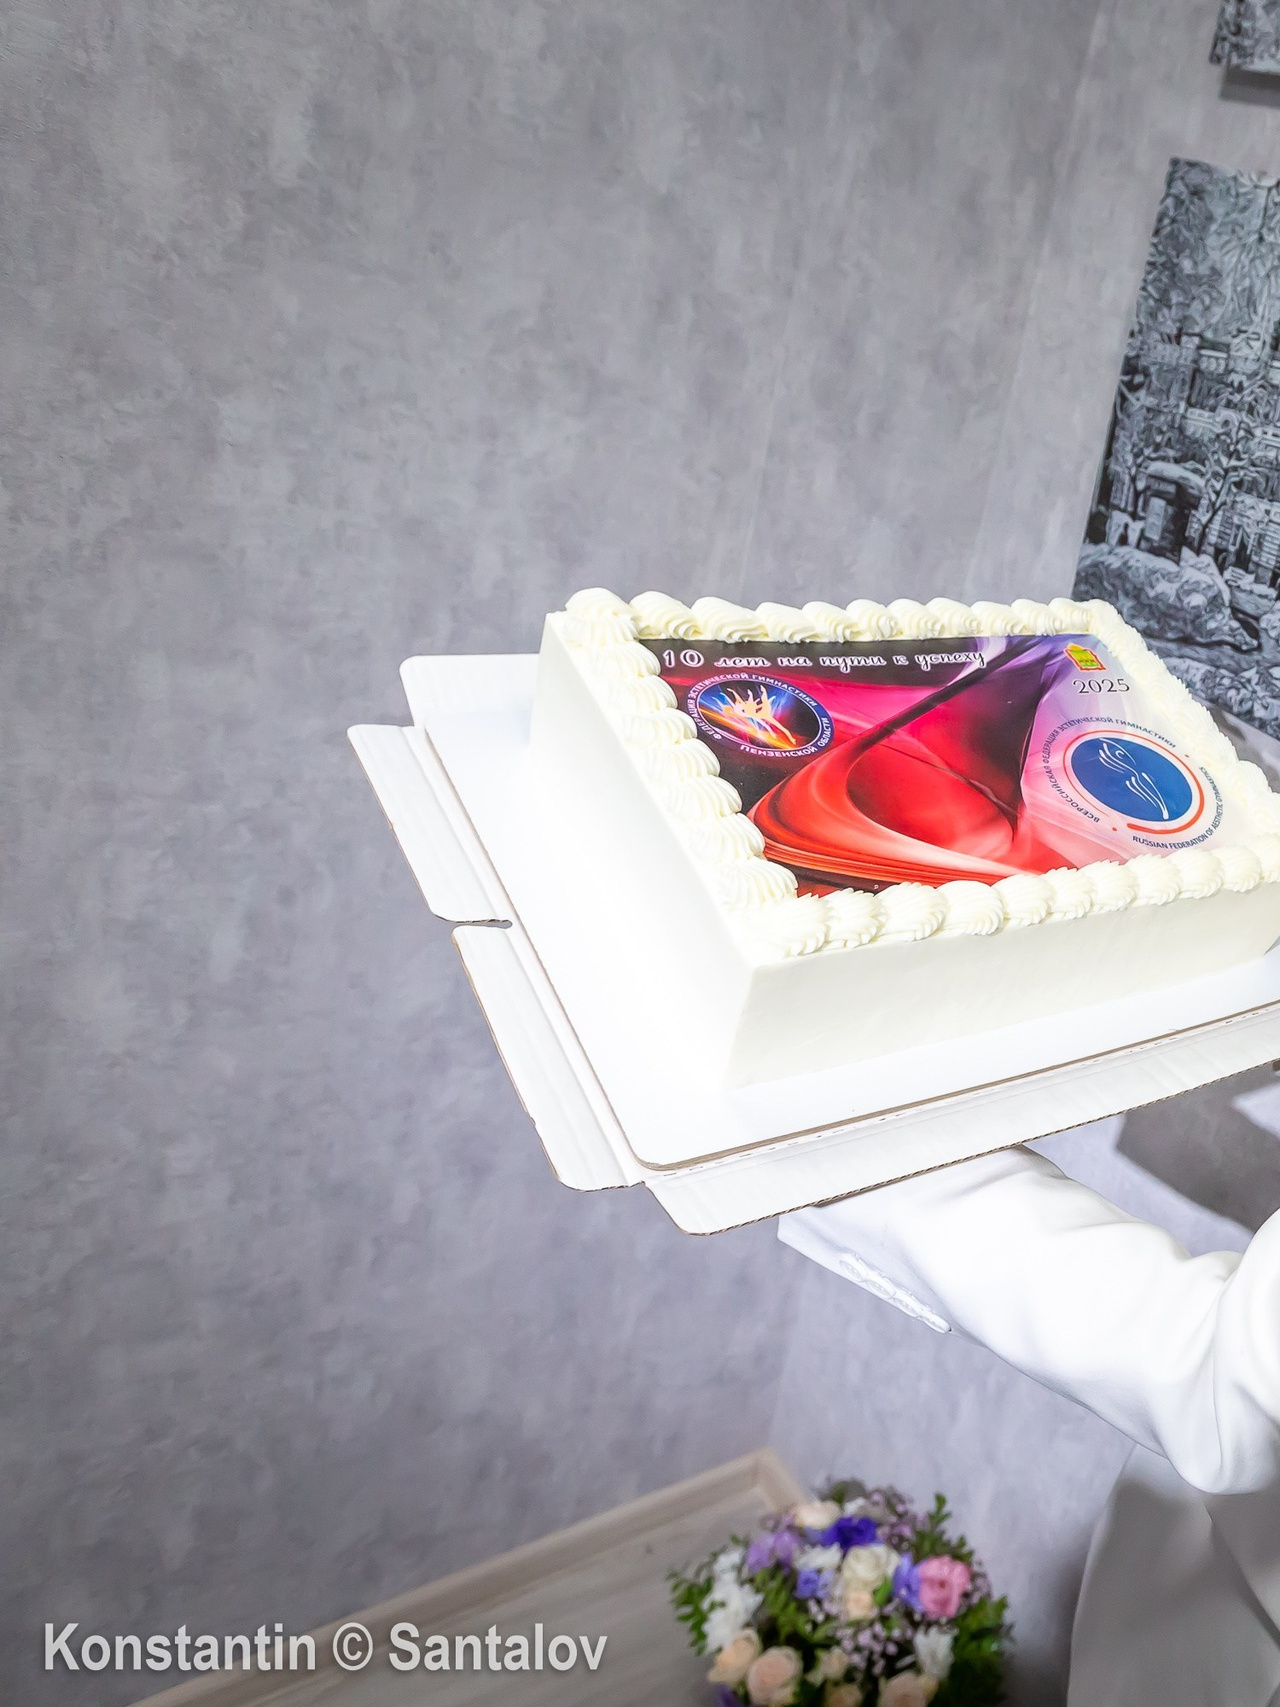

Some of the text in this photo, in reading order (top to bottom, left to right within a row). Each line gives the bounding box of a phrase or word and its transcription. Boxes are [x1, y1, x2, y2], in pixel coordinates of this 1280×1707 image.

[663, 649, 986, 673] 10 лет на пути к успеху
[687, 672, 818, 740] ФЕДЕРАЦИЯ ЭСТЕТИЧЕСКОЙ ГИМНАСТИКИ
[1073, 678, 1130, 694] 2025
[740, 717, 831, 758] ПЕНЗЕНСКОЙ ОБЛАСТИ
[1042, 716, 1176, 823] ВСЕРОССИЙСКАЯ ФЕДЕРАЦИЯ ЭСТЕТИЧЕСКОЙ ГИМНАСТИКИ
[1132, 835, 1168, 849] RUSSIAN
[1168, 834, 1209, 850] FEDERATION
[1205, 827, 1214, 836] OF
[1211, 802, 1223, 830] AESTHETIC
